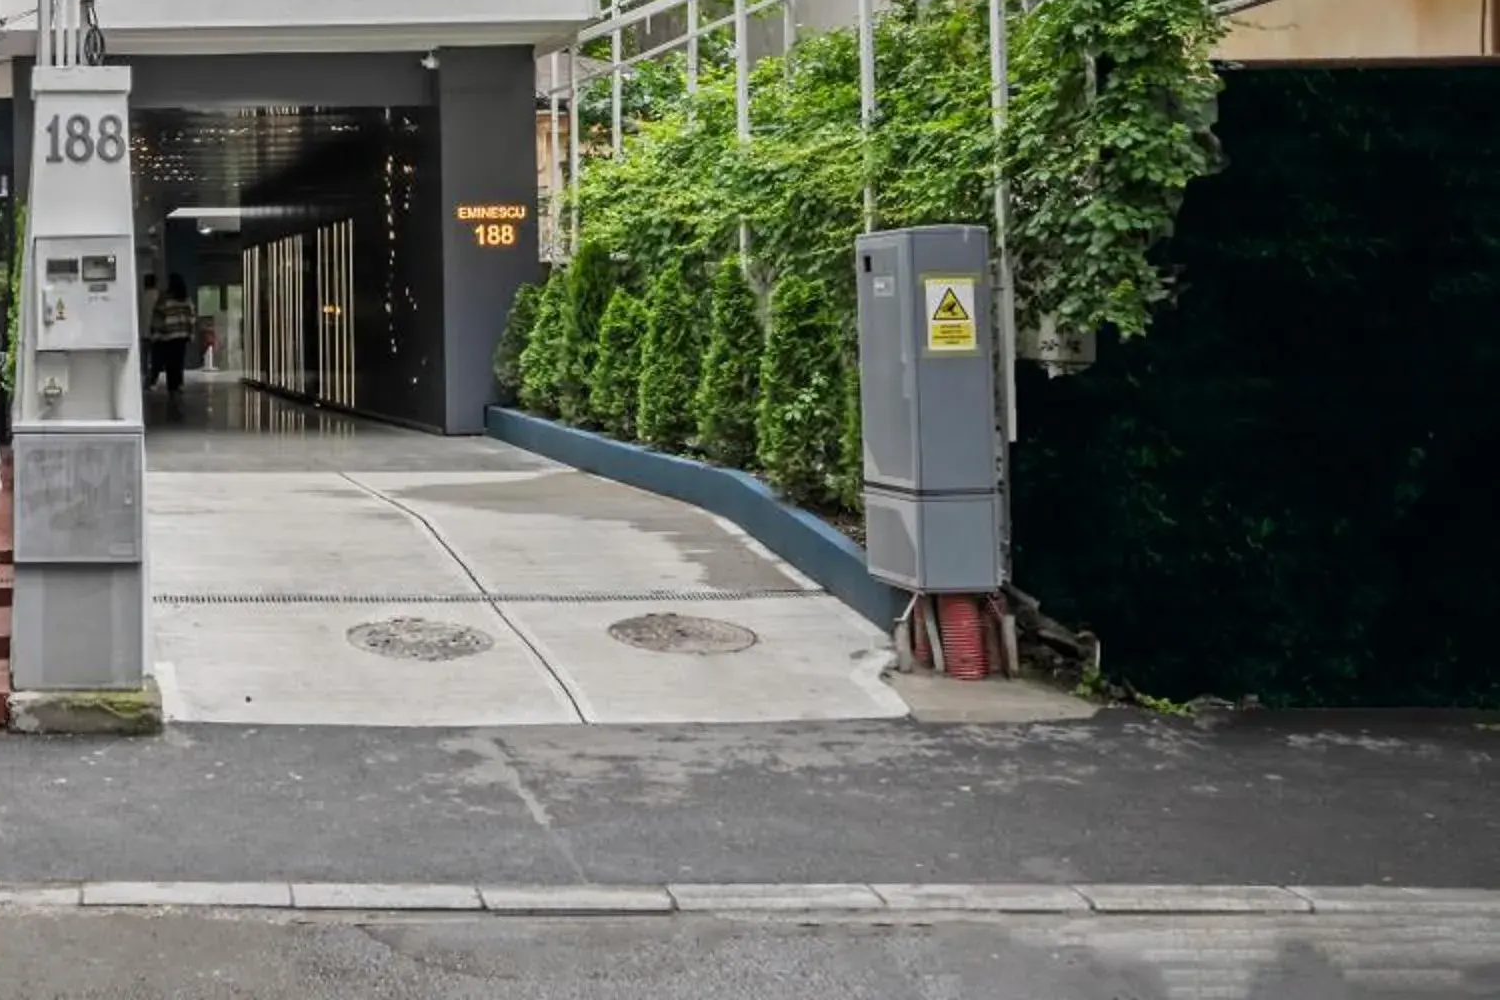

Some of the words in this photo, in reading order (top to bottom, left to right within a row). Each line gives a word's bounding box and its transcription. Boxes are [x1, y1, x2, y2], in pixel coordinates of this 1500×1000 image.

[45, 113, 127, 164] 188
[457, 204, 526, 219] EMINESCU
[475, 223, 514, 246] 188
